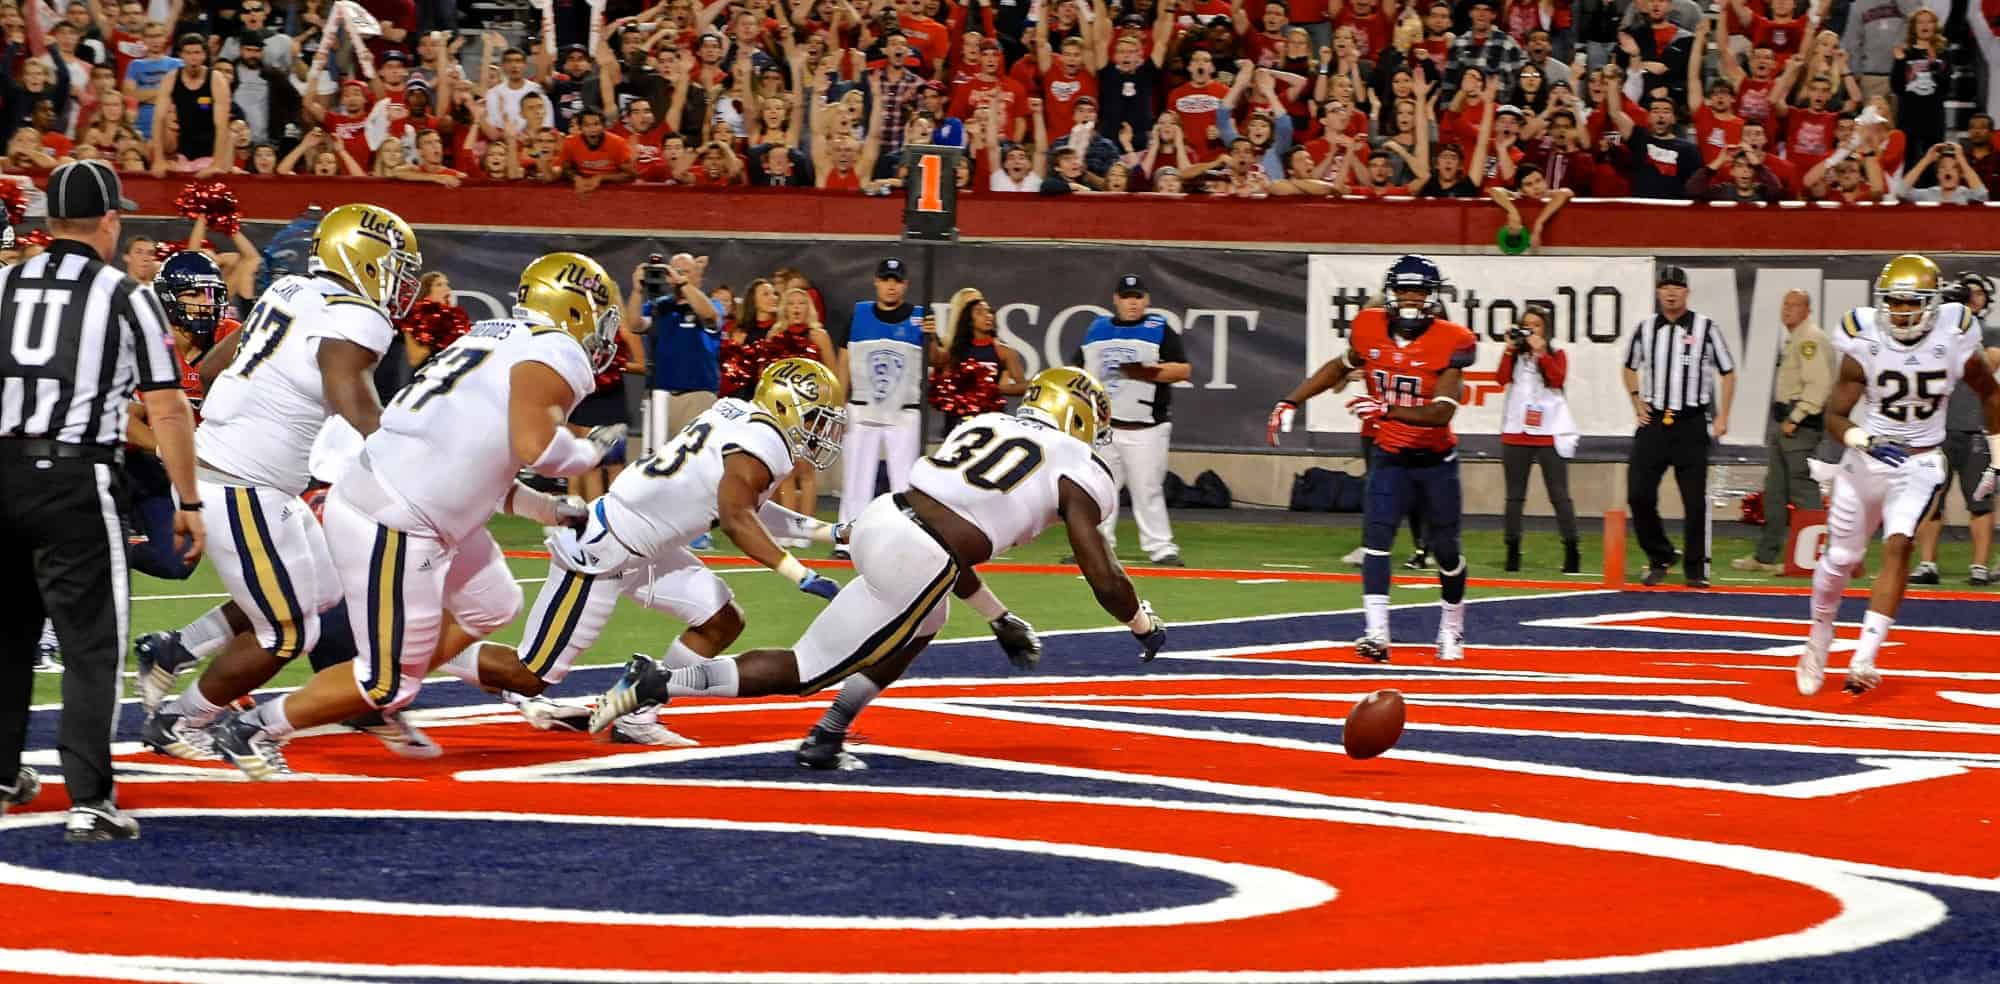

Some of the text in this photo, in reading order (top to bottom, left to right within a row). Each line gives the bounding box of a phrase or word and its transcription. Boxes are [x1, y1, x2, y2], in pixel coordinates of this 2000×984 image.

[917, 154, 943, 212] 1
[12, 288, 73, 366] U
[1877, 369, 1948, 423] 25
[928, 426, 1046, 494] 30
